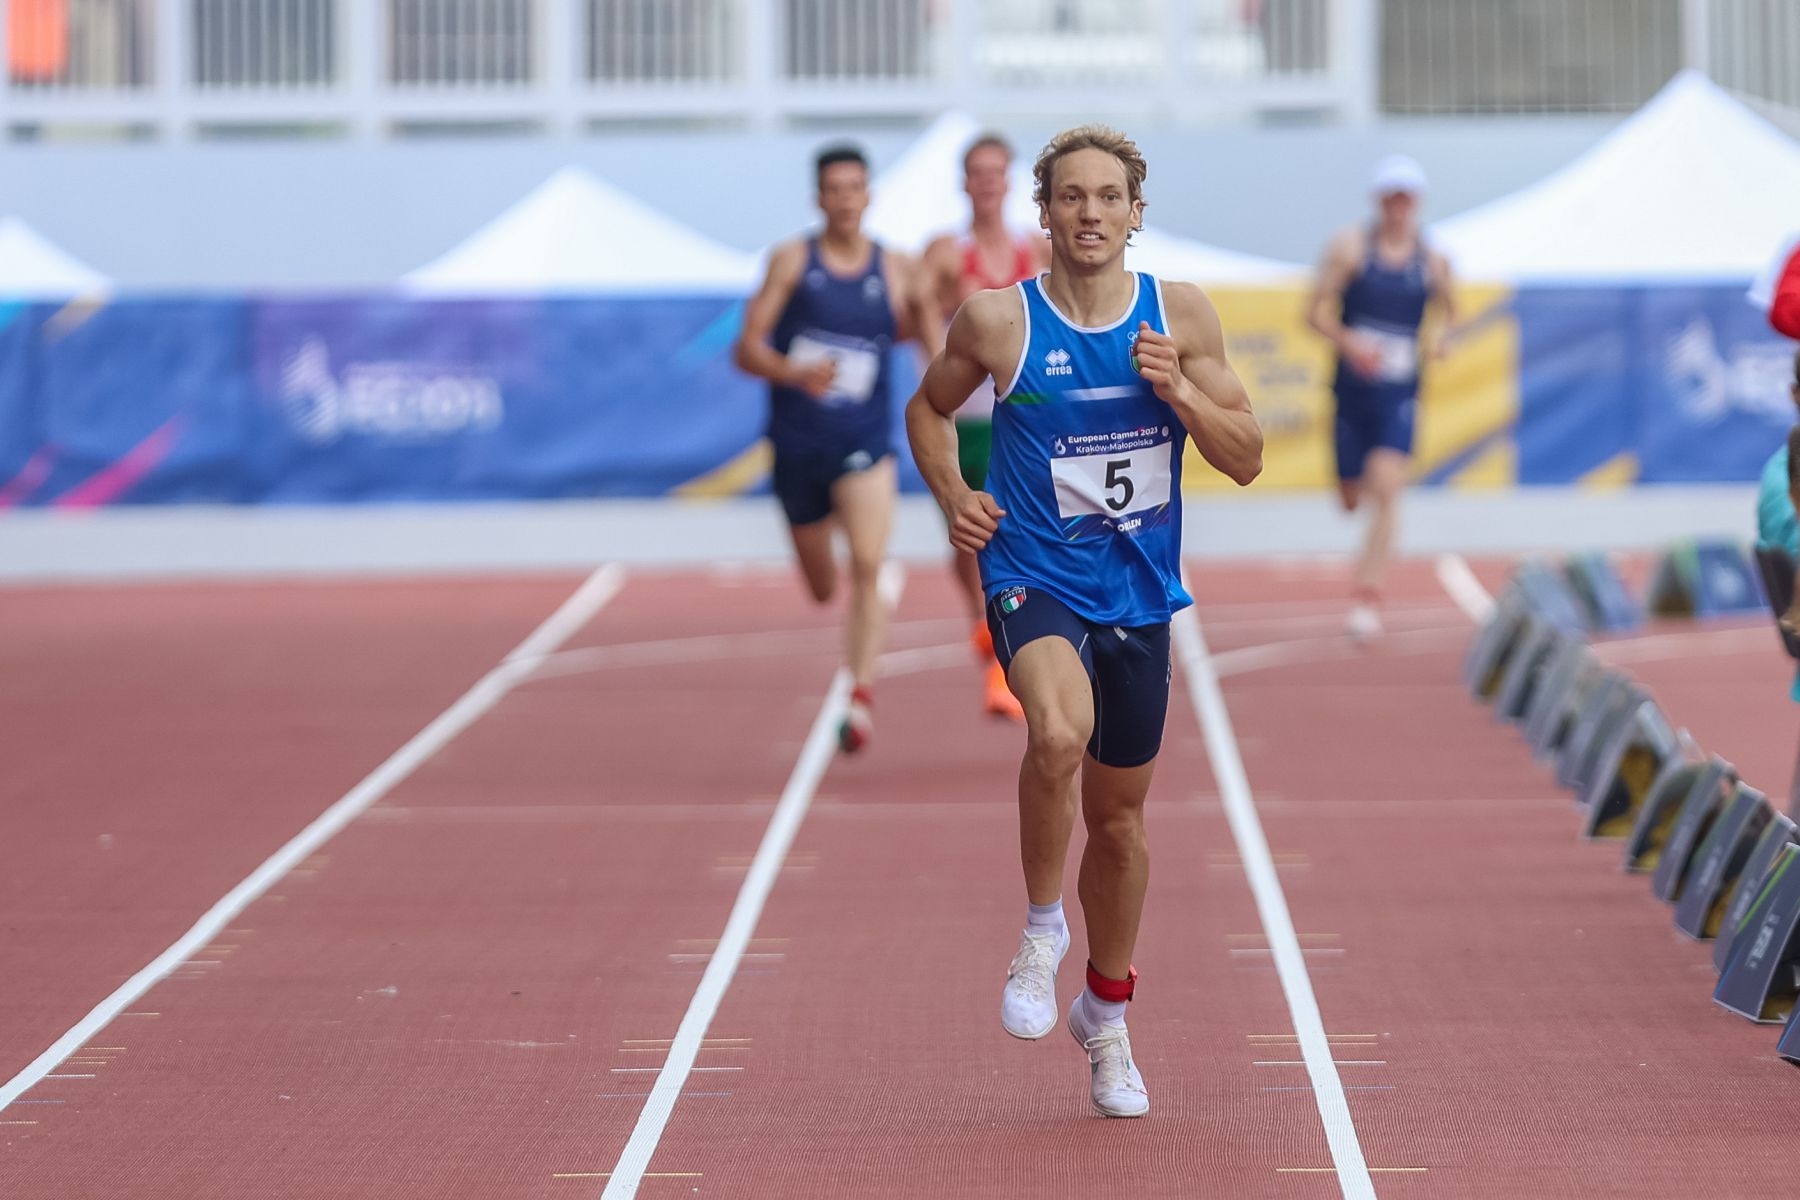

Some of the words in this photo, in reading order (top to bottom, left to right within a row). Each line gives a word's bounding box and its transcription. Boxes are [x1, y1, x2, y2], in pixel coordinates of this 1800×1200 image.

[1068, 432, 1109, 444] European
[1111, 430, 1139, 440] Games
[1140, 425, 1158, 436] 2023
[1104, 458, 1134, 511] 5
[1117, 517, 1142, 532] ORLEN
